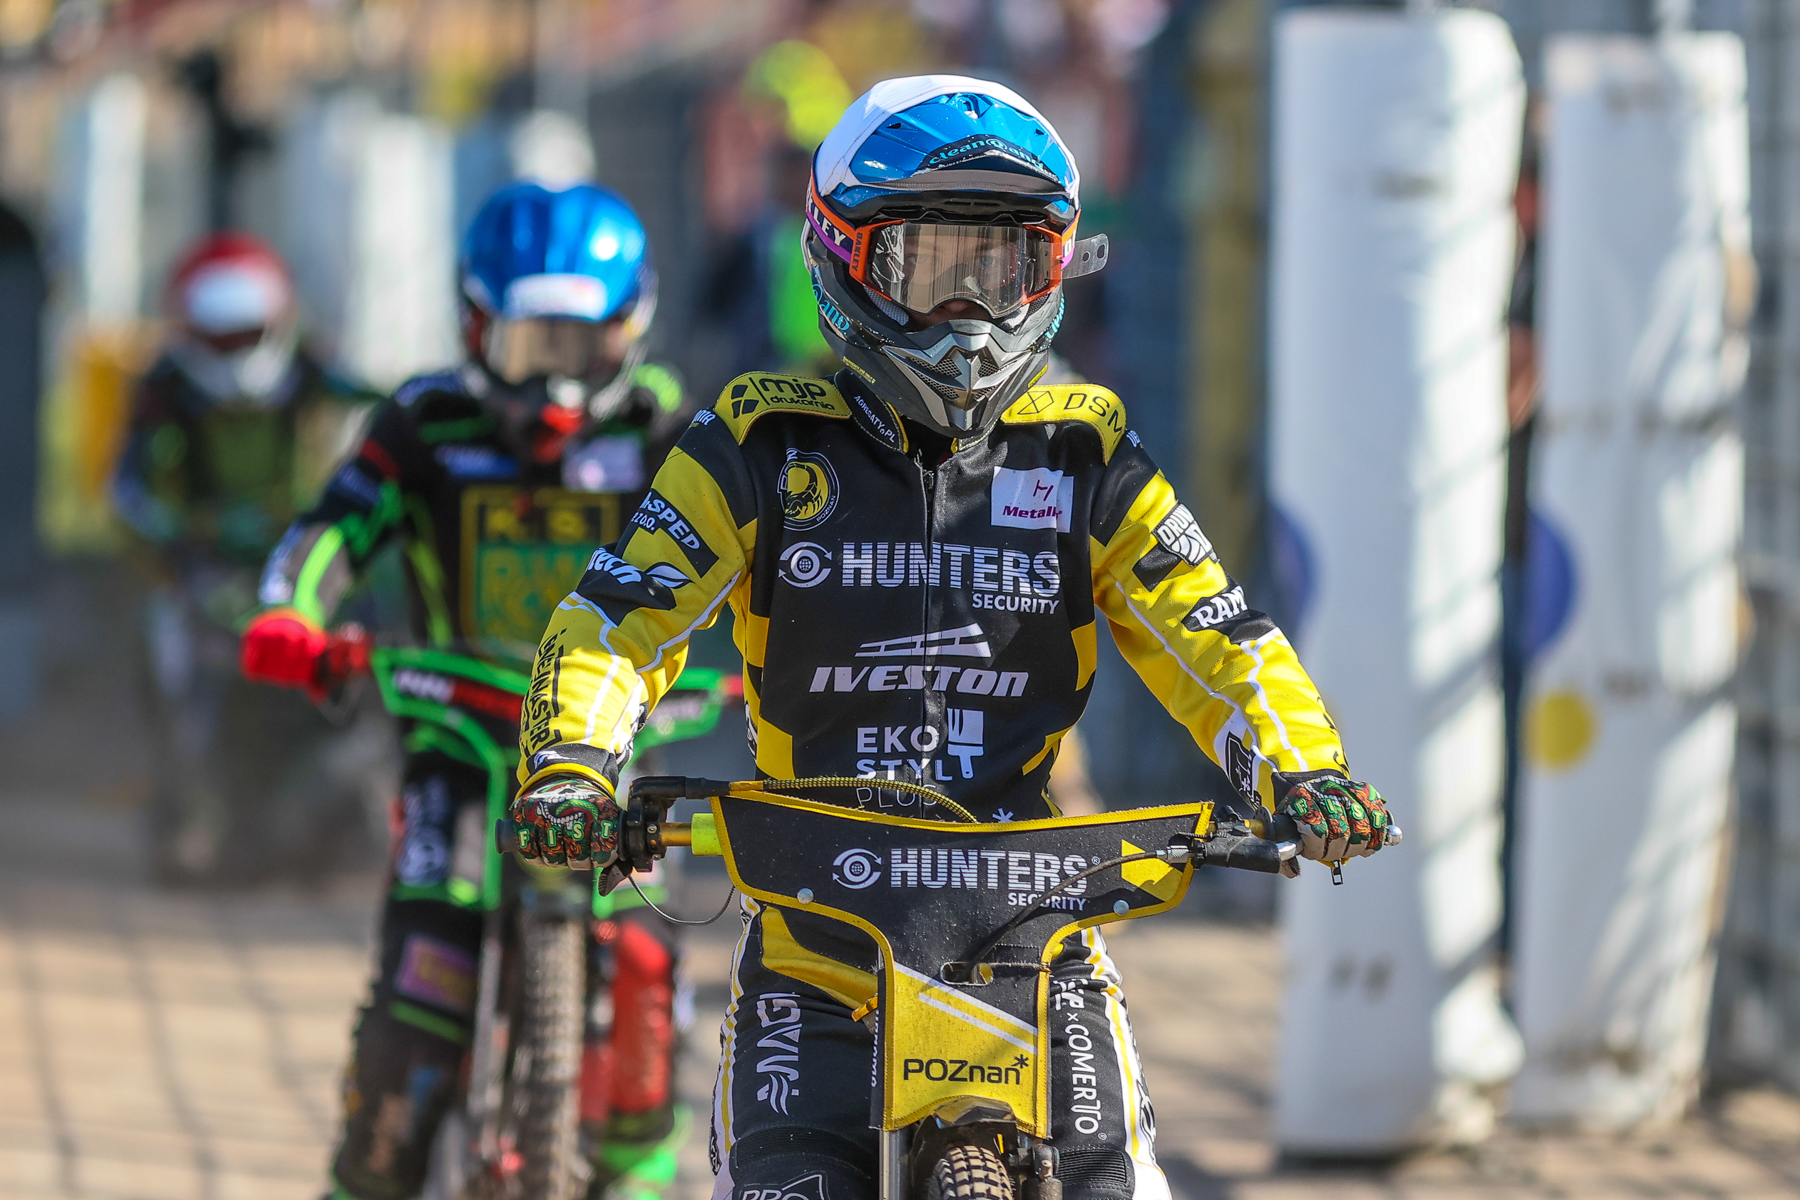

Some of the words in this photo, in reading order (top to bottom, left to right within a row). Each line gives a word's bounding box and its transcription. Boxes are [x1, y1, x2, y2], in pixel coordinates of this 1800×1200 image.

[852, 231, 864, 272] OAKLEY
[758, 378, 827, 400] mjp
[770, 395, 835, 411] drukarnia
[841, 541, 1061, 597] HUNTERS
[971, 593, 1060, 615] SECURITY
[1190, 585, 1248, 628] RAM
[856, 725, 940, 754] EKO
[856, 758, 953, 781] STYL
[856, 784, 938, 808] PLUS
[1064, 1023, 1102, 1135] COMERTO
